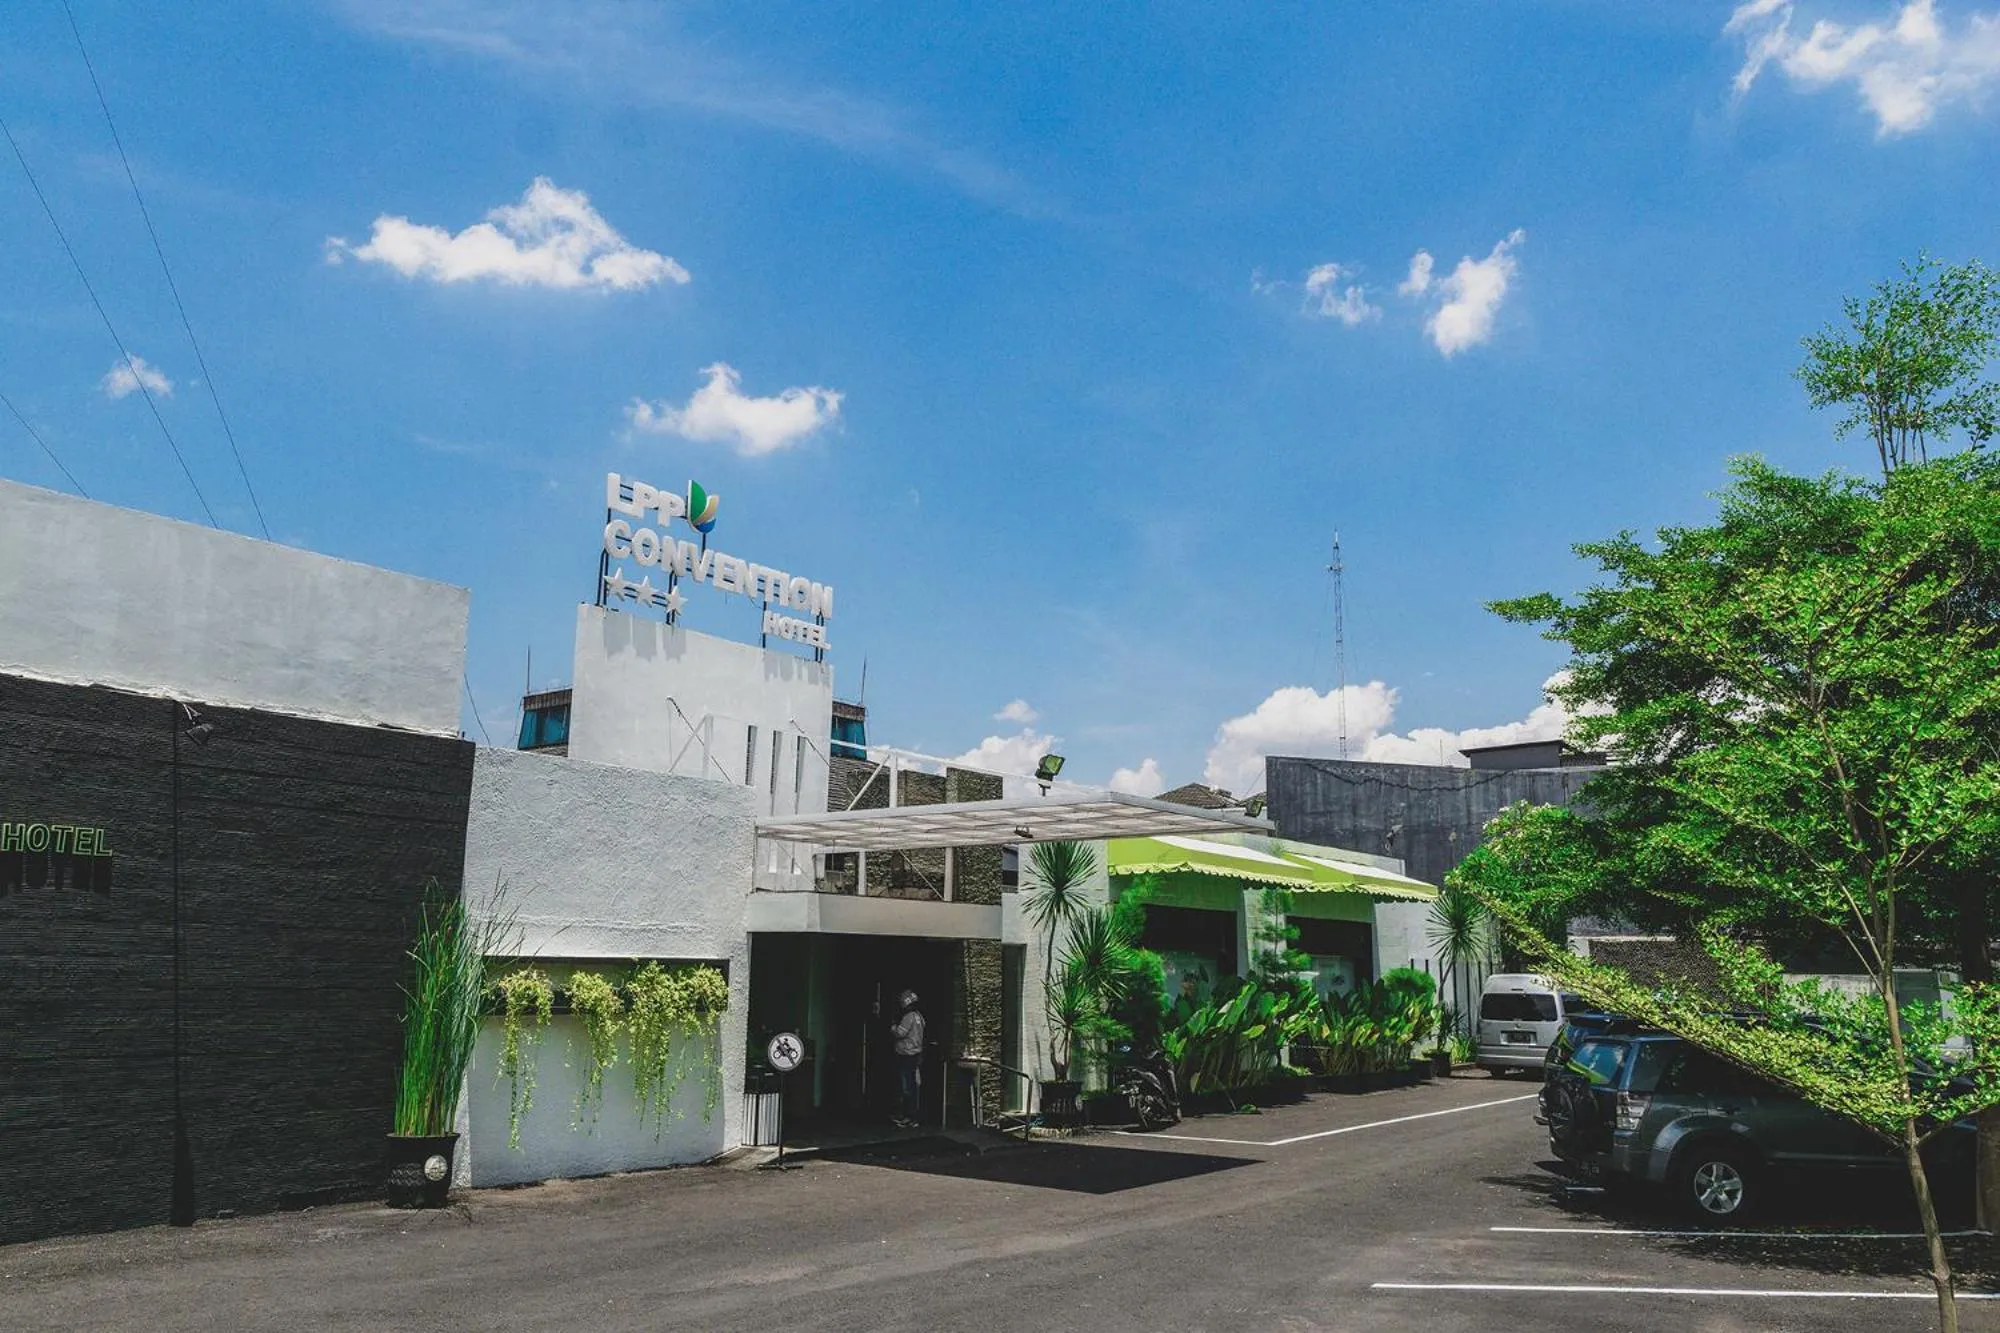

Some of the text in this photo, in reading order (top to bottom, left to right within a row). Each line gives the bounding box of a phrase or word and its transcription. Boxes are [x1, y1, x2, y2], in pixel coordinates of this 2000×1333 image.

[607, 472, 686, 527] LPP
[604, 519, 833, 620] CONVENTION
[763, 610, 831, 650] HOTEL
[0, 822, 113, 857] HOTEL
